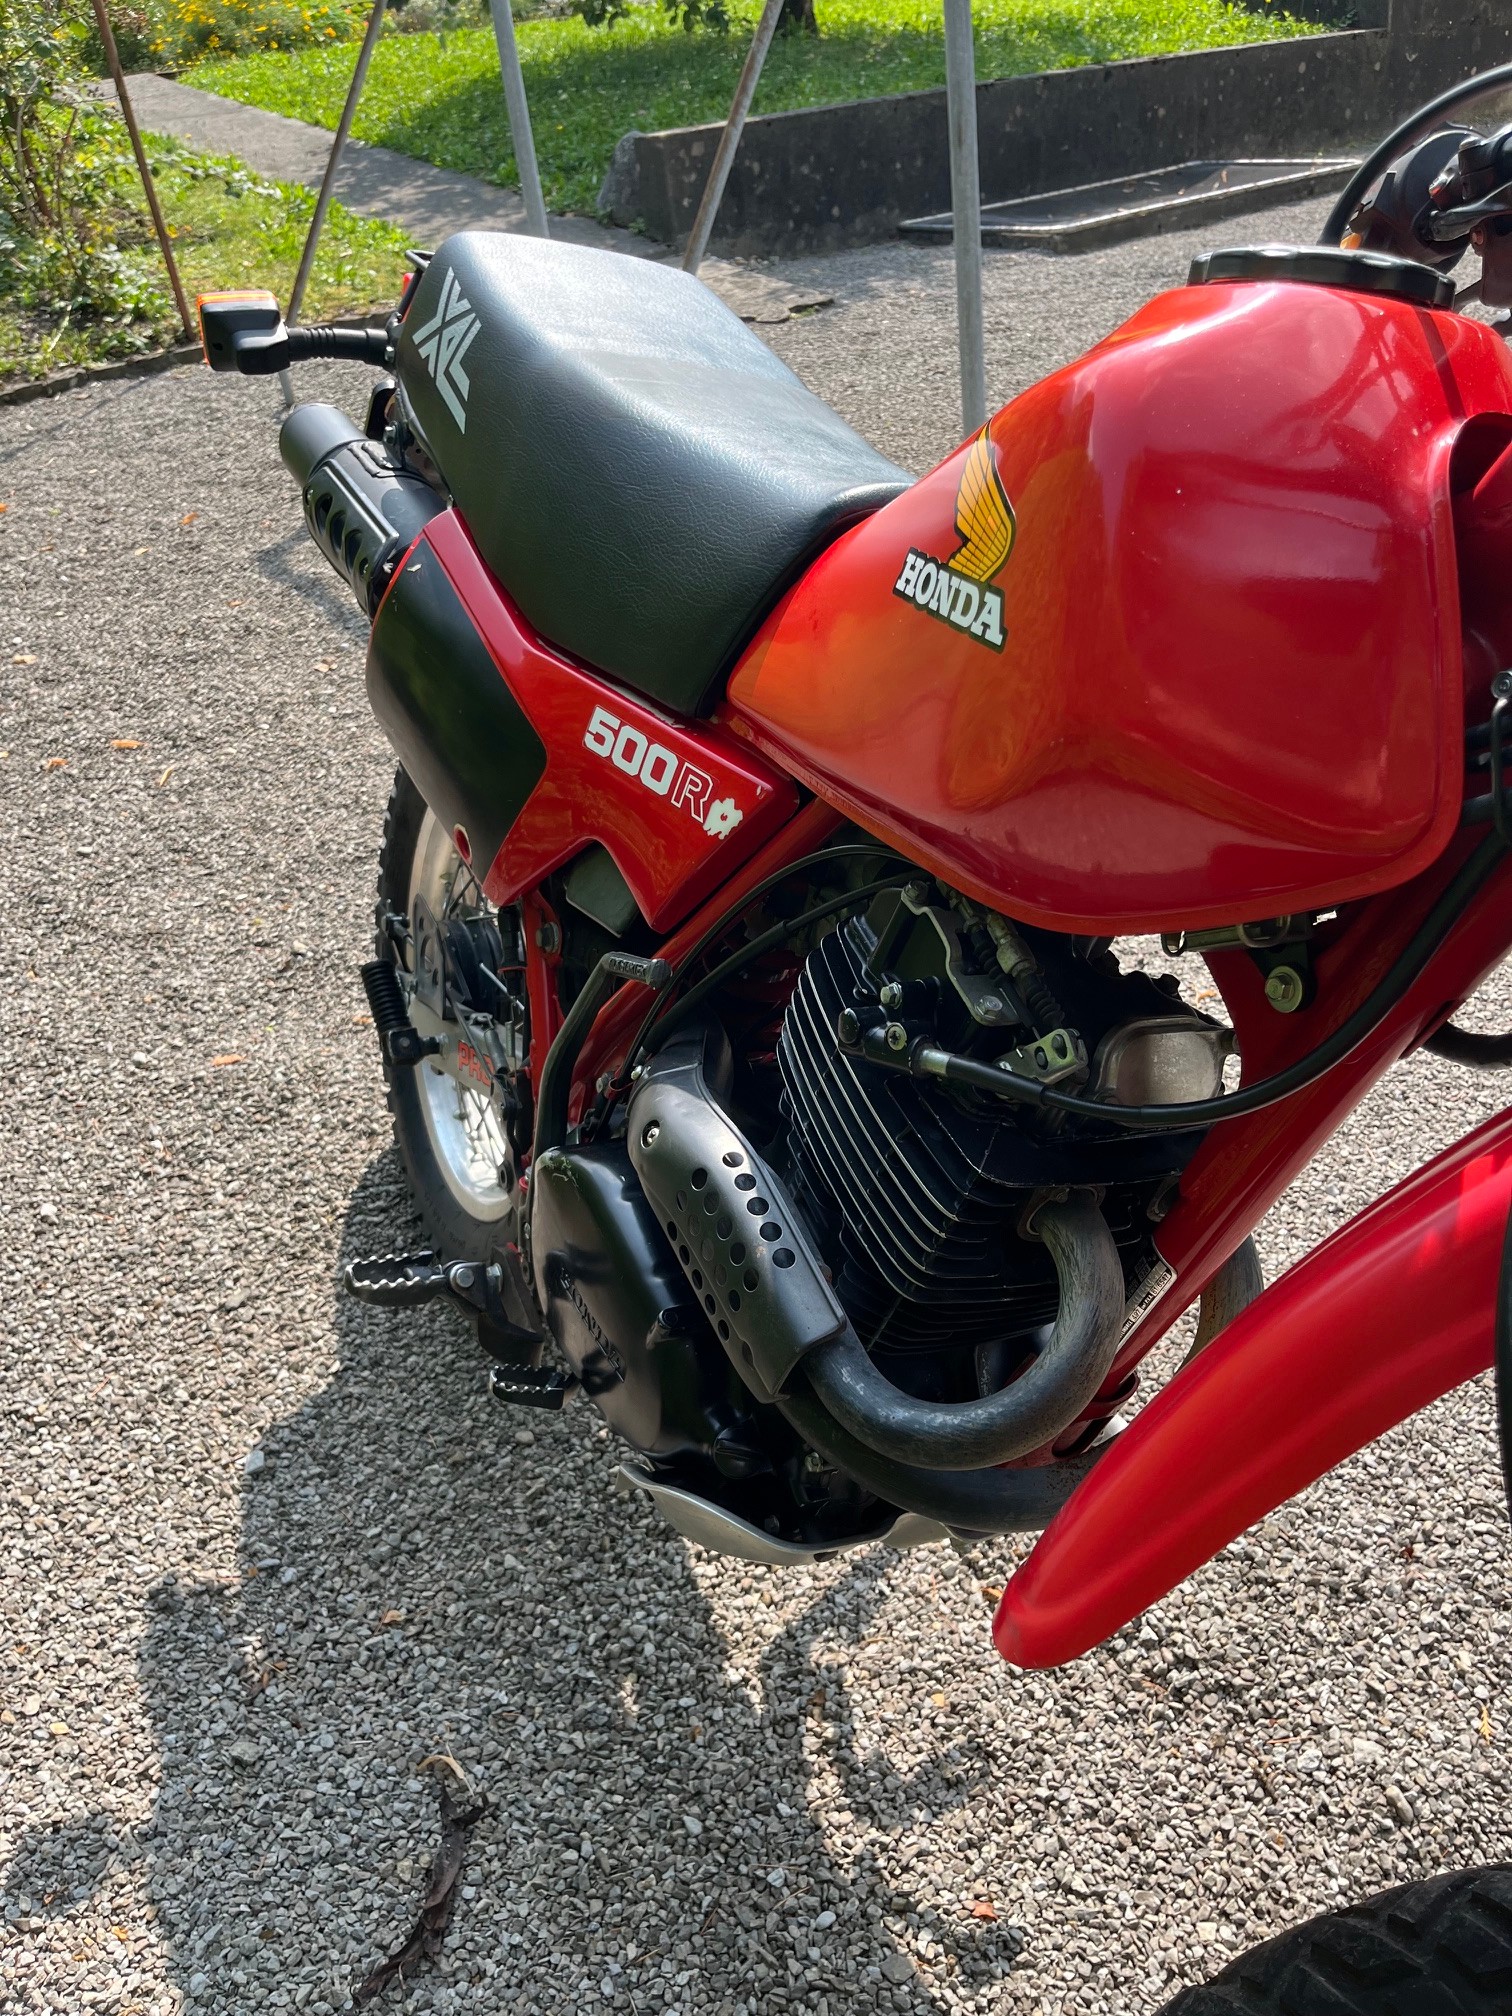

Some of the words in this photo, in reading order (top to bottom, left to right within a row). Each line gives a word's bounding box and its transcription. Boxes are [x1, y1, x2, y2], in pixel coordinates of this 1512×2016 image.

[412, 266, 482, 435] XL
[895, 552, 1003, 646] HONDA
[584, 706, 713, 823] 500R
